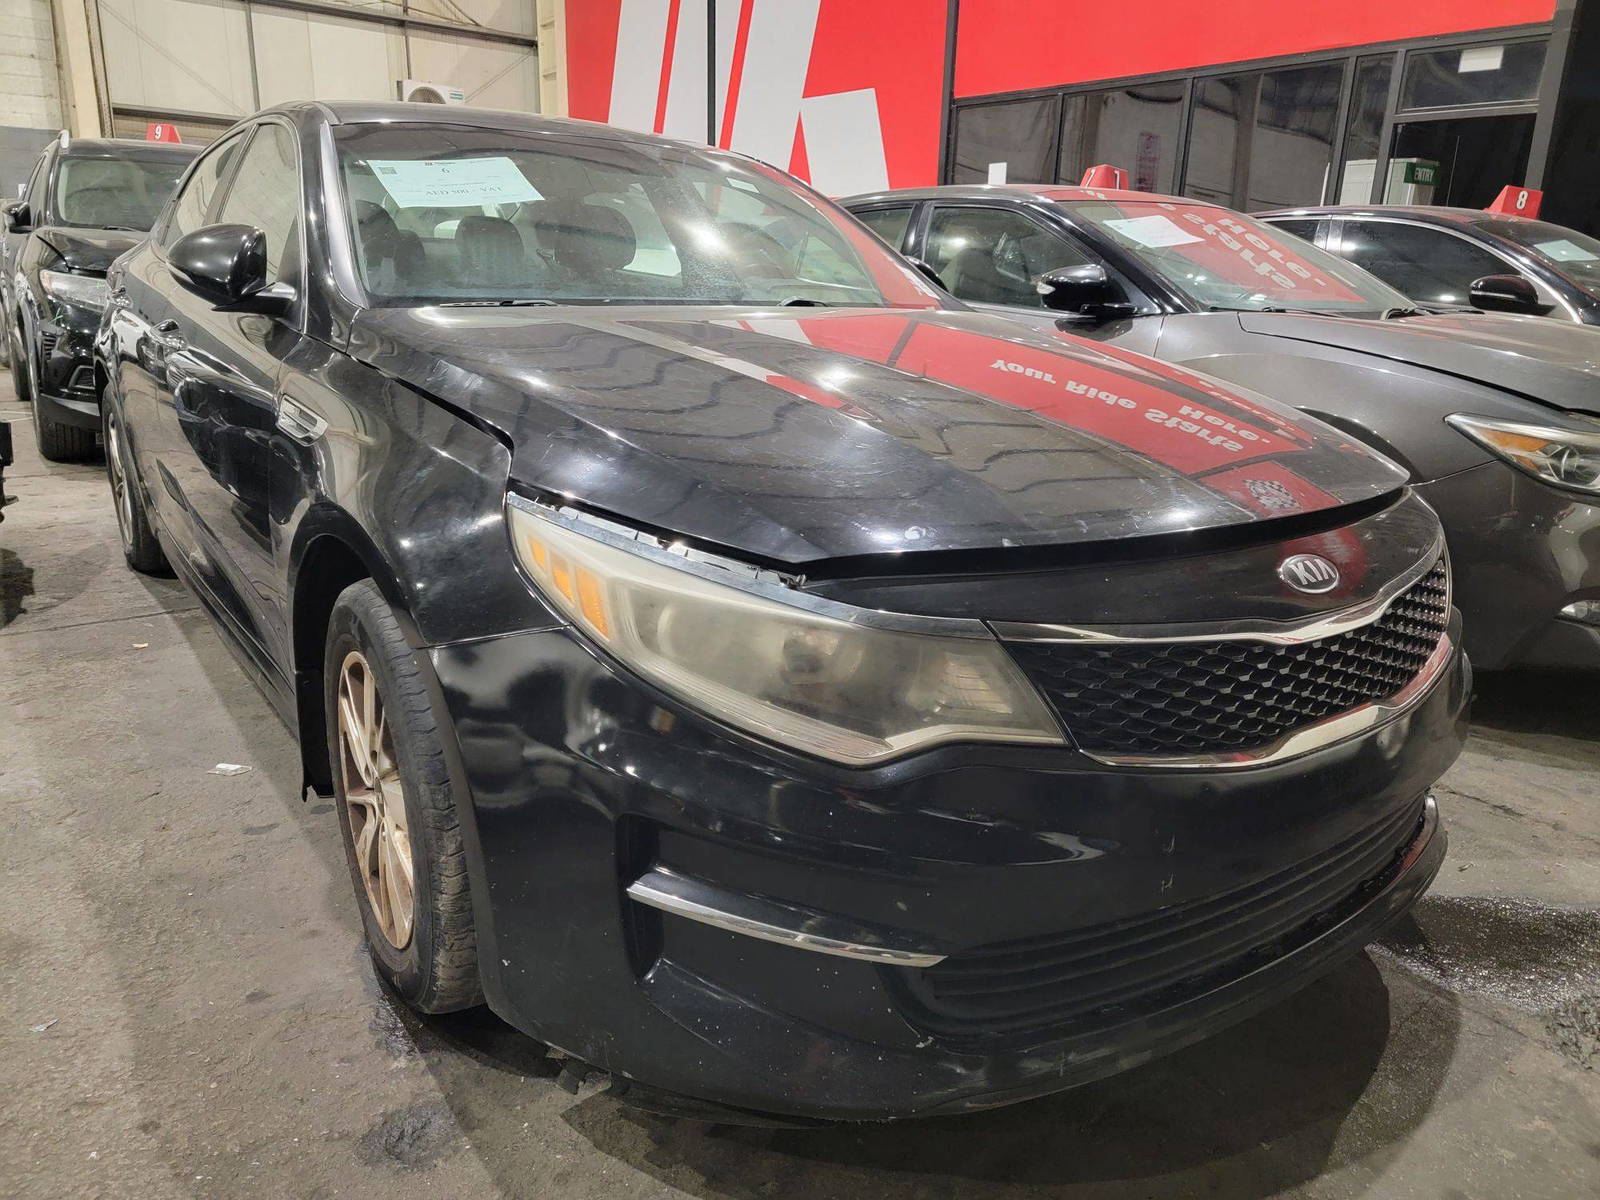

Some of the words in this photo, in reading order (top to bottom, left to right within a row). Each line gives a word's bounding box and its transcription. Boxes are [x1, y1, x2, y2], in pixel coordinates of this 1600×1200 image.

[154, 125, 162, 140] 9
[1413, 167, 1435, 182] ENTRY
[1516, 190, 1529, 210] 8
[1286, 558, 1336, 585] KIA
